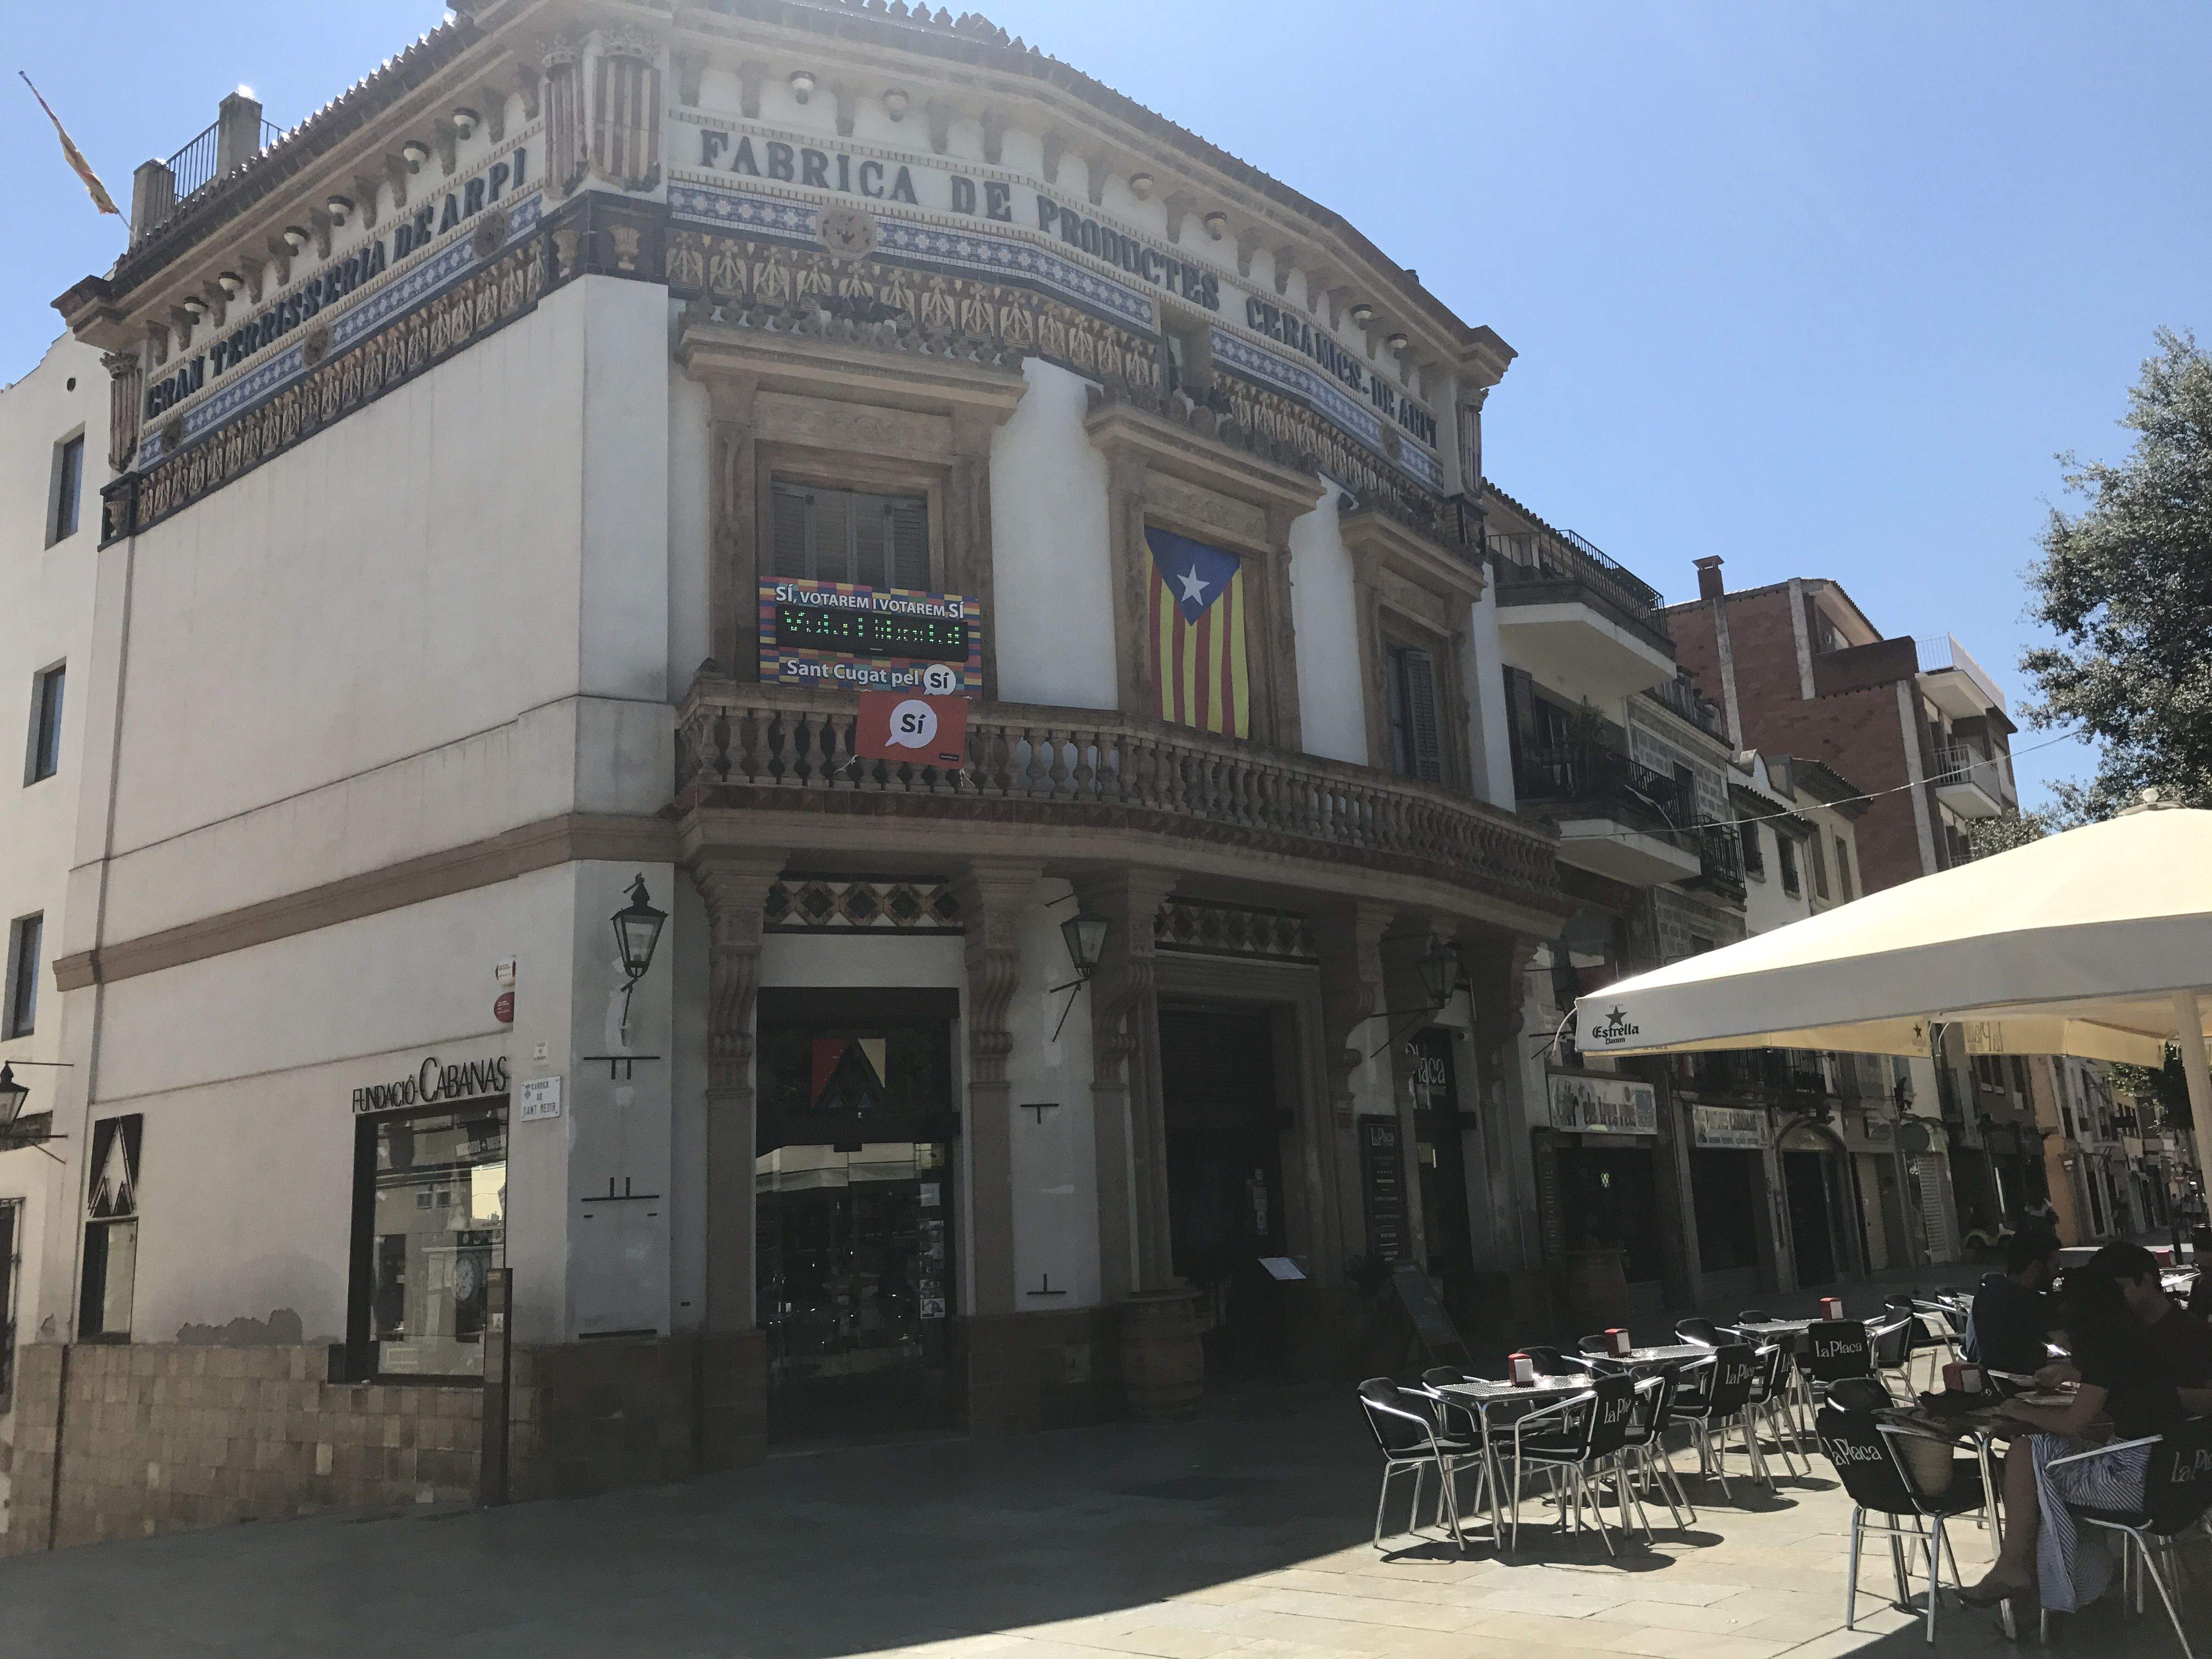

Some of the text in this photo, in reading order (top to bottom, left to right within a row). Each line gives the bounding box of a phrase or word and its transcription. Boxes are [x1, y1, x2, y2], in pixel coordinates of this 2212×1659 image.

[392, 205, 433, 264] DE
[437, 146, 526, 236] ARPI
[701, 129, 919, 205] FABRICA
[951, 175, 1013, 222] DE
[1036, 194, 1220, 312] PRODUCTES
[775, 584, 965, 619] SÍ, VOTAREM I VOTAREM SÍ
[787, 660, 950, 689] Sant Cugat pel Sí
[900, 713, 927, 734] Sí
[1592, 1023, 1639, 1039] Estrella
[1605, 1037, 1626, 1045] Damm
[353, 1056, 511, 1113] FUNDACIÓ CABANAS
[537, 1093, 543, 1101] DE
[523, 1104, 537, 1116] SANT
